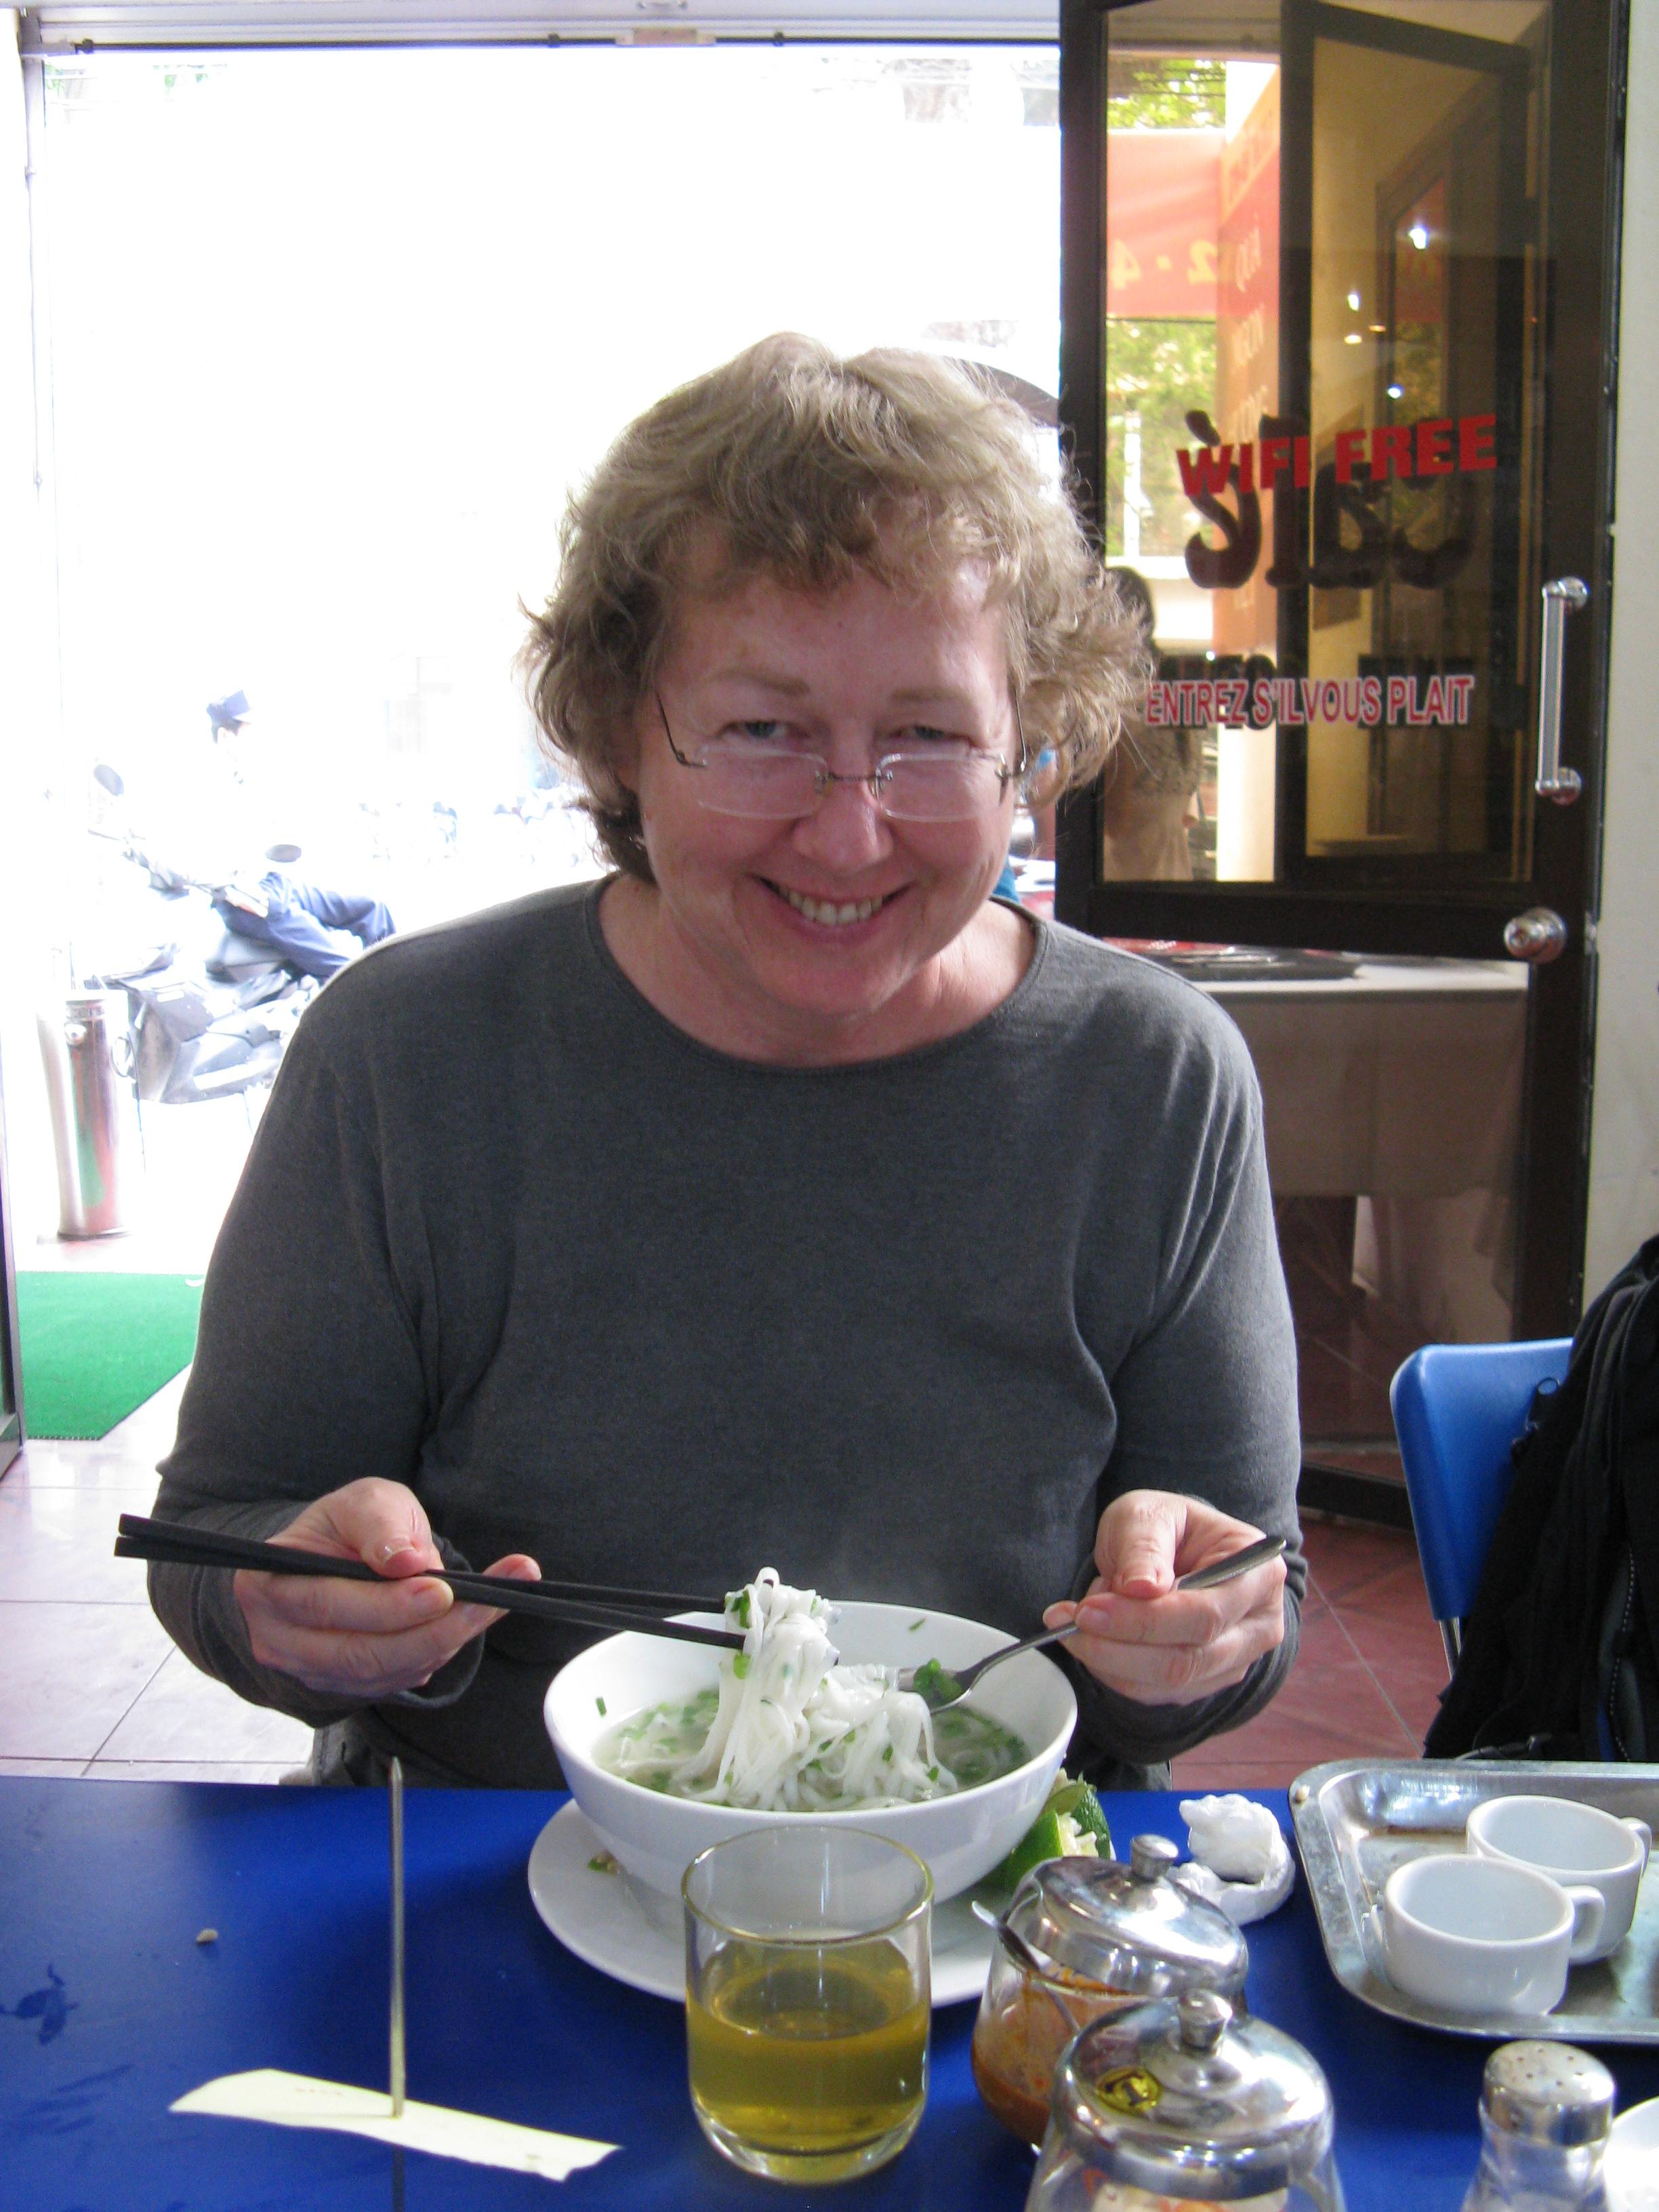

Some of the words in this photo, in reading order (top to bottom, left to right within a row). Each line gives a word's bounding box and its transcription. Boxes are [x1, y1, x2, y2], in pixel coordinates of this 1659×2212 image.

[1176, 434, 1310, 496] WIFI
[1335, 413, 1497, 484] FREE
[1146, 678, 1249, 724] ENTREZ
[1387, 674, 1475, 724] PLAIT
